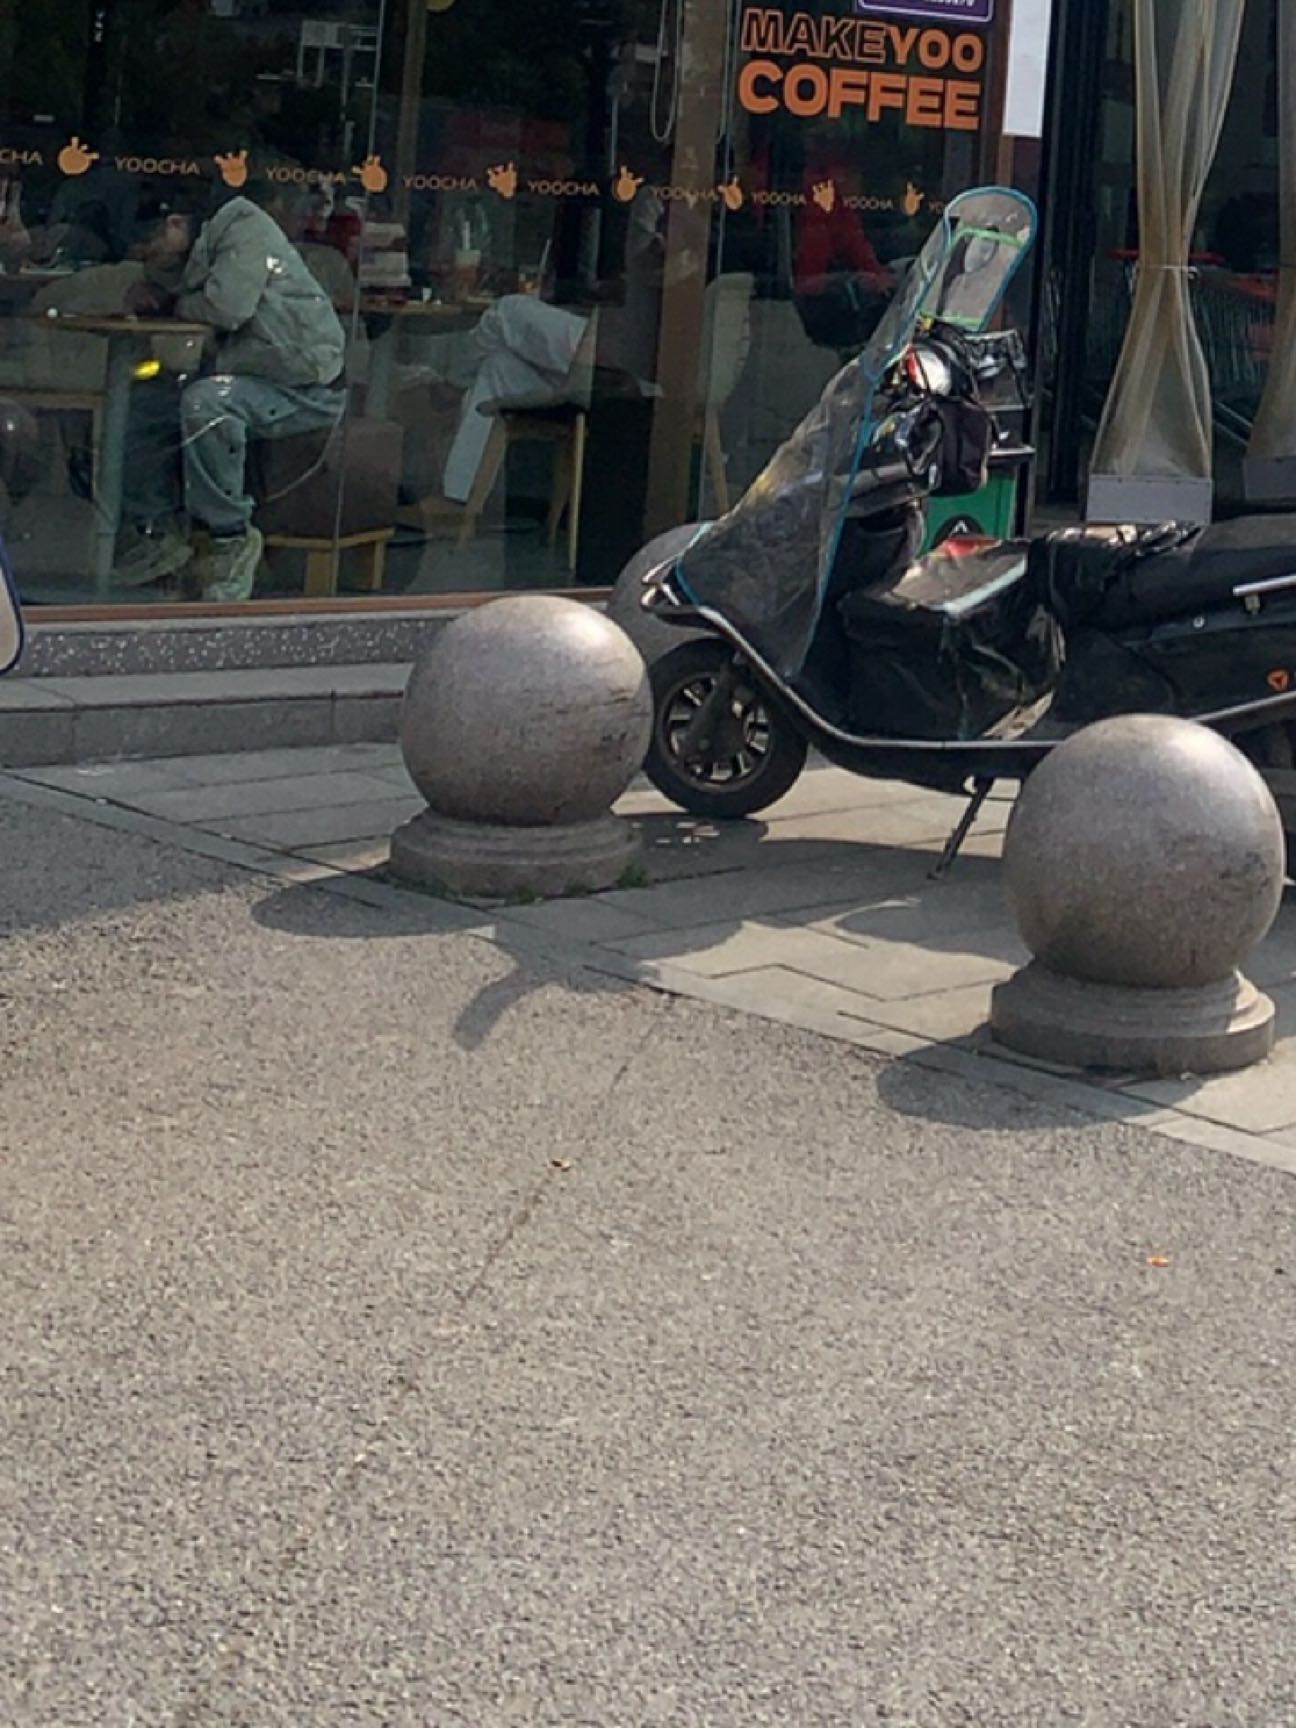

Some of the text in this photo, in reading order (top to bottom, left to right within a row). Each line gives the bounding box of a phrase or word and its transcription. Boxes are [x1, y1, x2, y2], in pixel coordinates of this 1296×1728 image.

[738, 59, 981, 131] COFFEE
[114, 156, 200, 175] YOOCHA
[528, 180, 600, 196] YOOCHA
